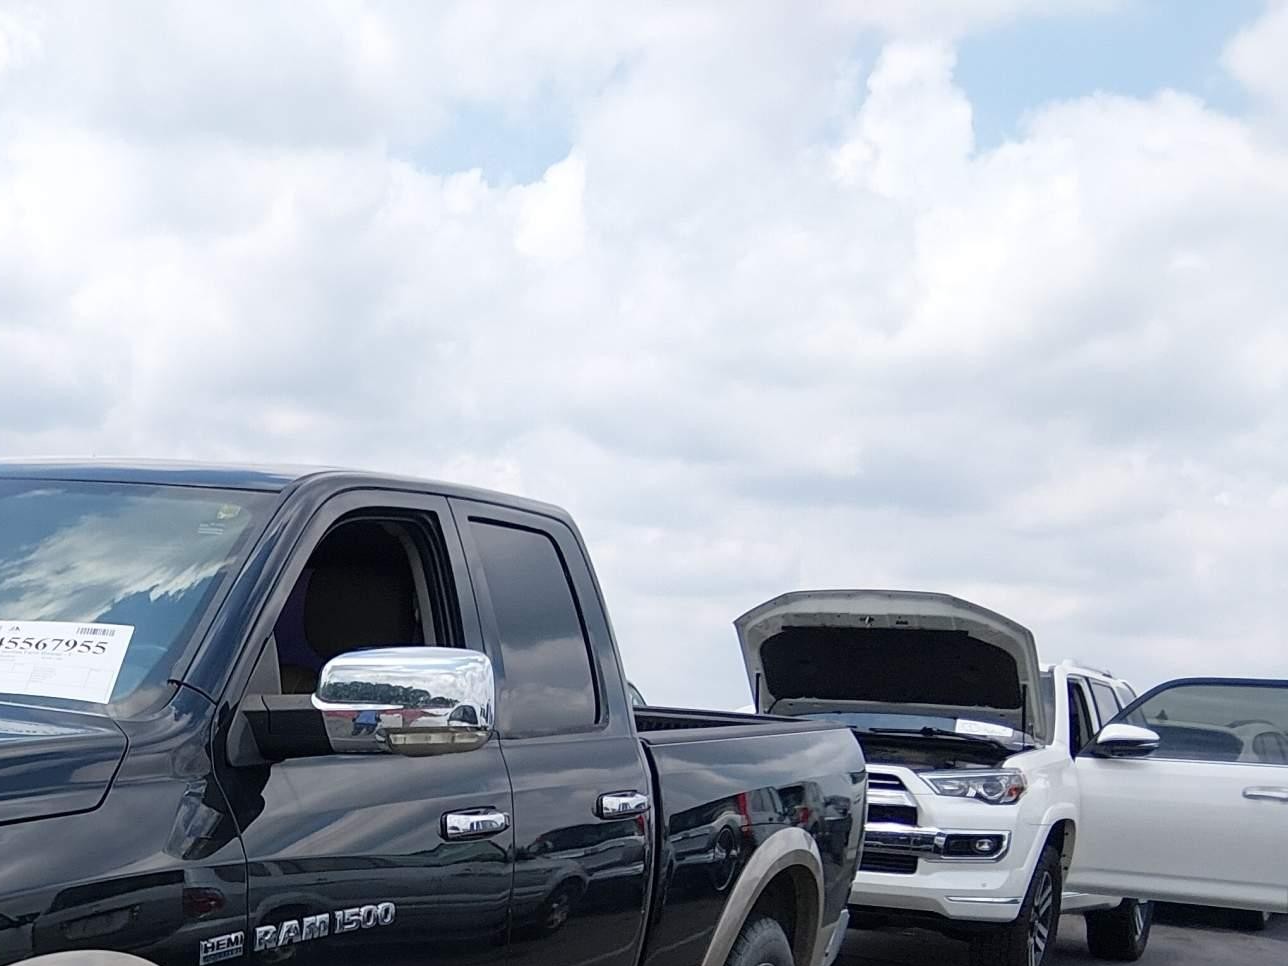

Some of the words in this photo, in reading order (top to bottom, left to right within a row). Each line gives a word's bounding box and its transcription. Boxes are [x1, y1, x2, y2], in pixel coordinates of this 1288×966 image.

[202, 932, 244, 954] HEMI
[254, 912, 330, 951] RAM
[334, 902, 396, 934] 1500
